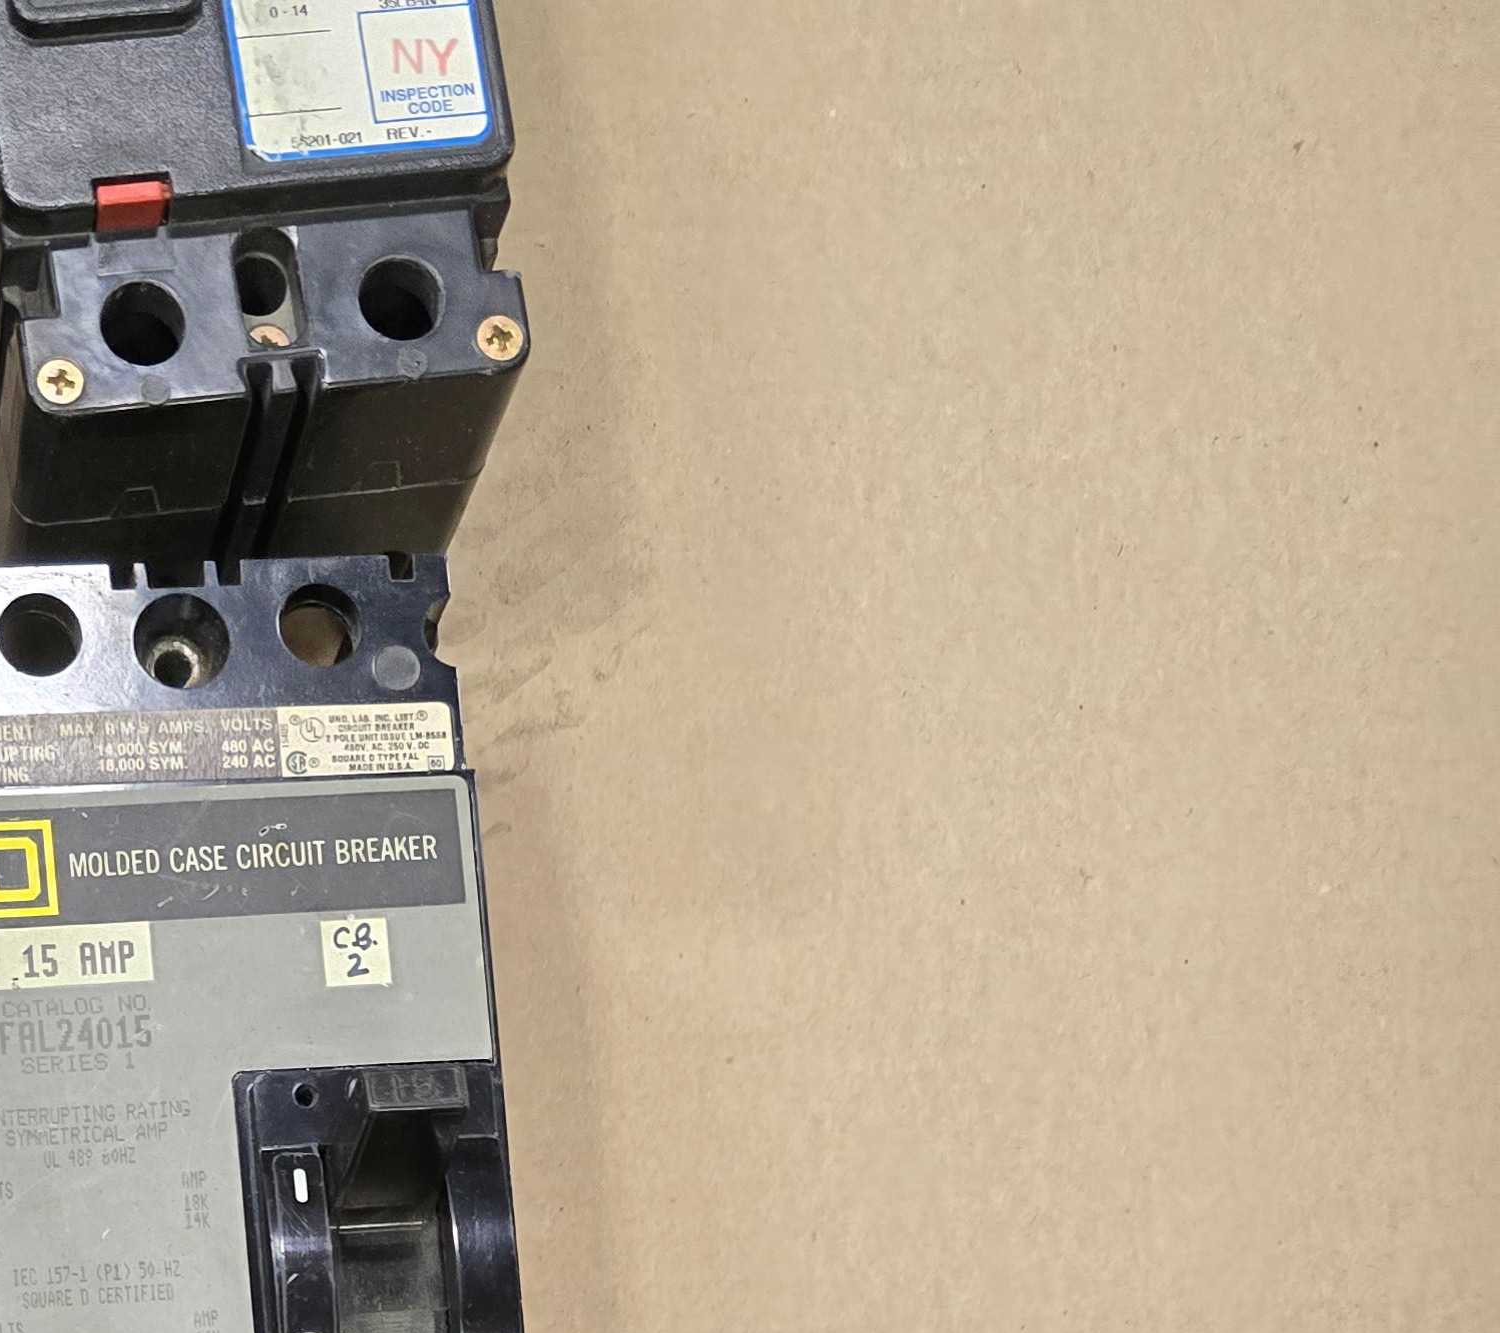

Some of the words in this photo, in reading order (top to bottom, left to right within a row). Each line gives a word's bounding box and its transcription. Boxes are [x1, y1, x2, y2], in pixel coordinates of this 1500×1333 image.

[293, 5, 309, 17] 14
[392, 38, 458, 76] NY
[381, 83, 475, 103] INSPECTION
[408, 100, 454, 115] CODE
[221, 717, 273, 731] VOLTS
[375, 722, 415, 731] BREAKER
[222, 740, 247, 753] 480
[252, 738, 275, 752] AC
[99, 757, 144, 773] 18,000
[150, 756, 188, 771] SYM.
[223, 755, 247, 770] 240
[253, 754, 276, 768] AC
[69, 850, 160, 879] MOLDED
[169, 846, 226, 873] CASE
[236, 840, 326, 870] CIRCUIT
[335, 835, 438, 864] BREAKER
[22, 943, 58, 979] 15
[79, 940, 135, 976] AMP
[346, 952, 371, 977] 2
[2, 997, 103, 1018] CATALOG
[0, 1015, 153, 1055] FAL24015
[21, 1053, 108, 1075] SERIES
[126, 1052, 136, 1070] 1
[126, 1100, 191, 1120] RATING
